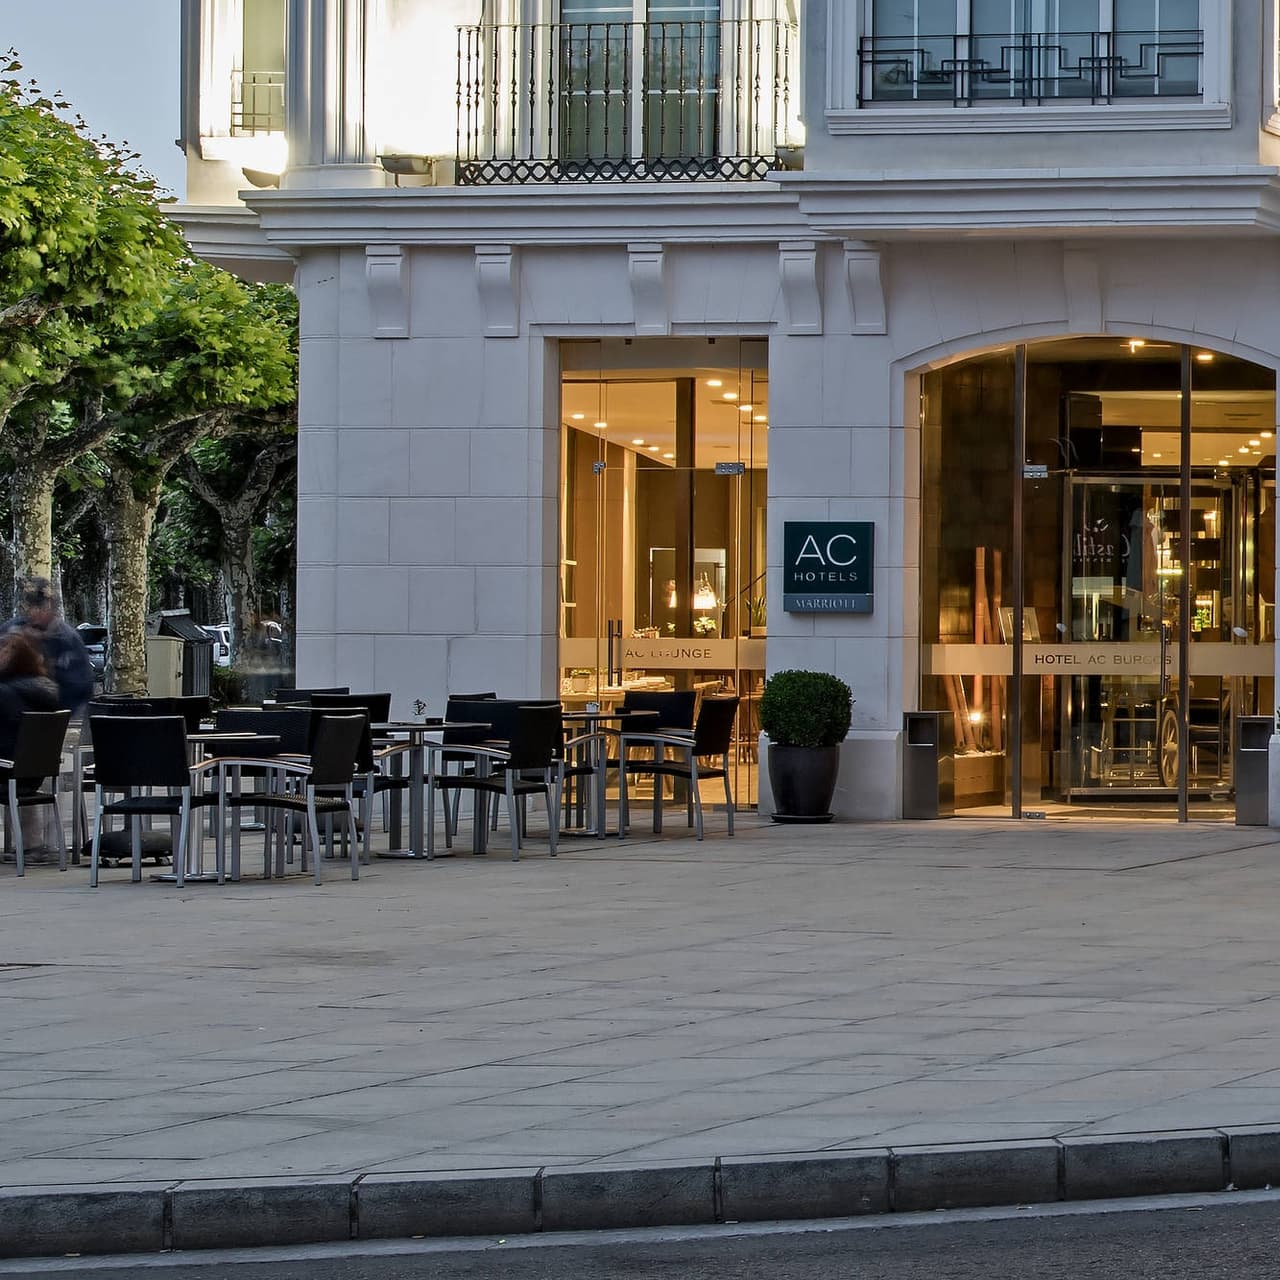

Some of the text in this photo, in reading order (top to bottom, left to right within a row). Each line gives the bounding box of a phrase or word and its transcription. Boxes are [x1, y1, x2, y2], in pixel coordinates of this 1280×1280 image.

[795, 534, 857, 566] AC
[794, 572, 858, 582] HOTELS
[794, 599, 856, 609] MARRIOTT
[1035, 654, 1082, 665] HOTEL
[1088, 654, 1106, 665] AC
